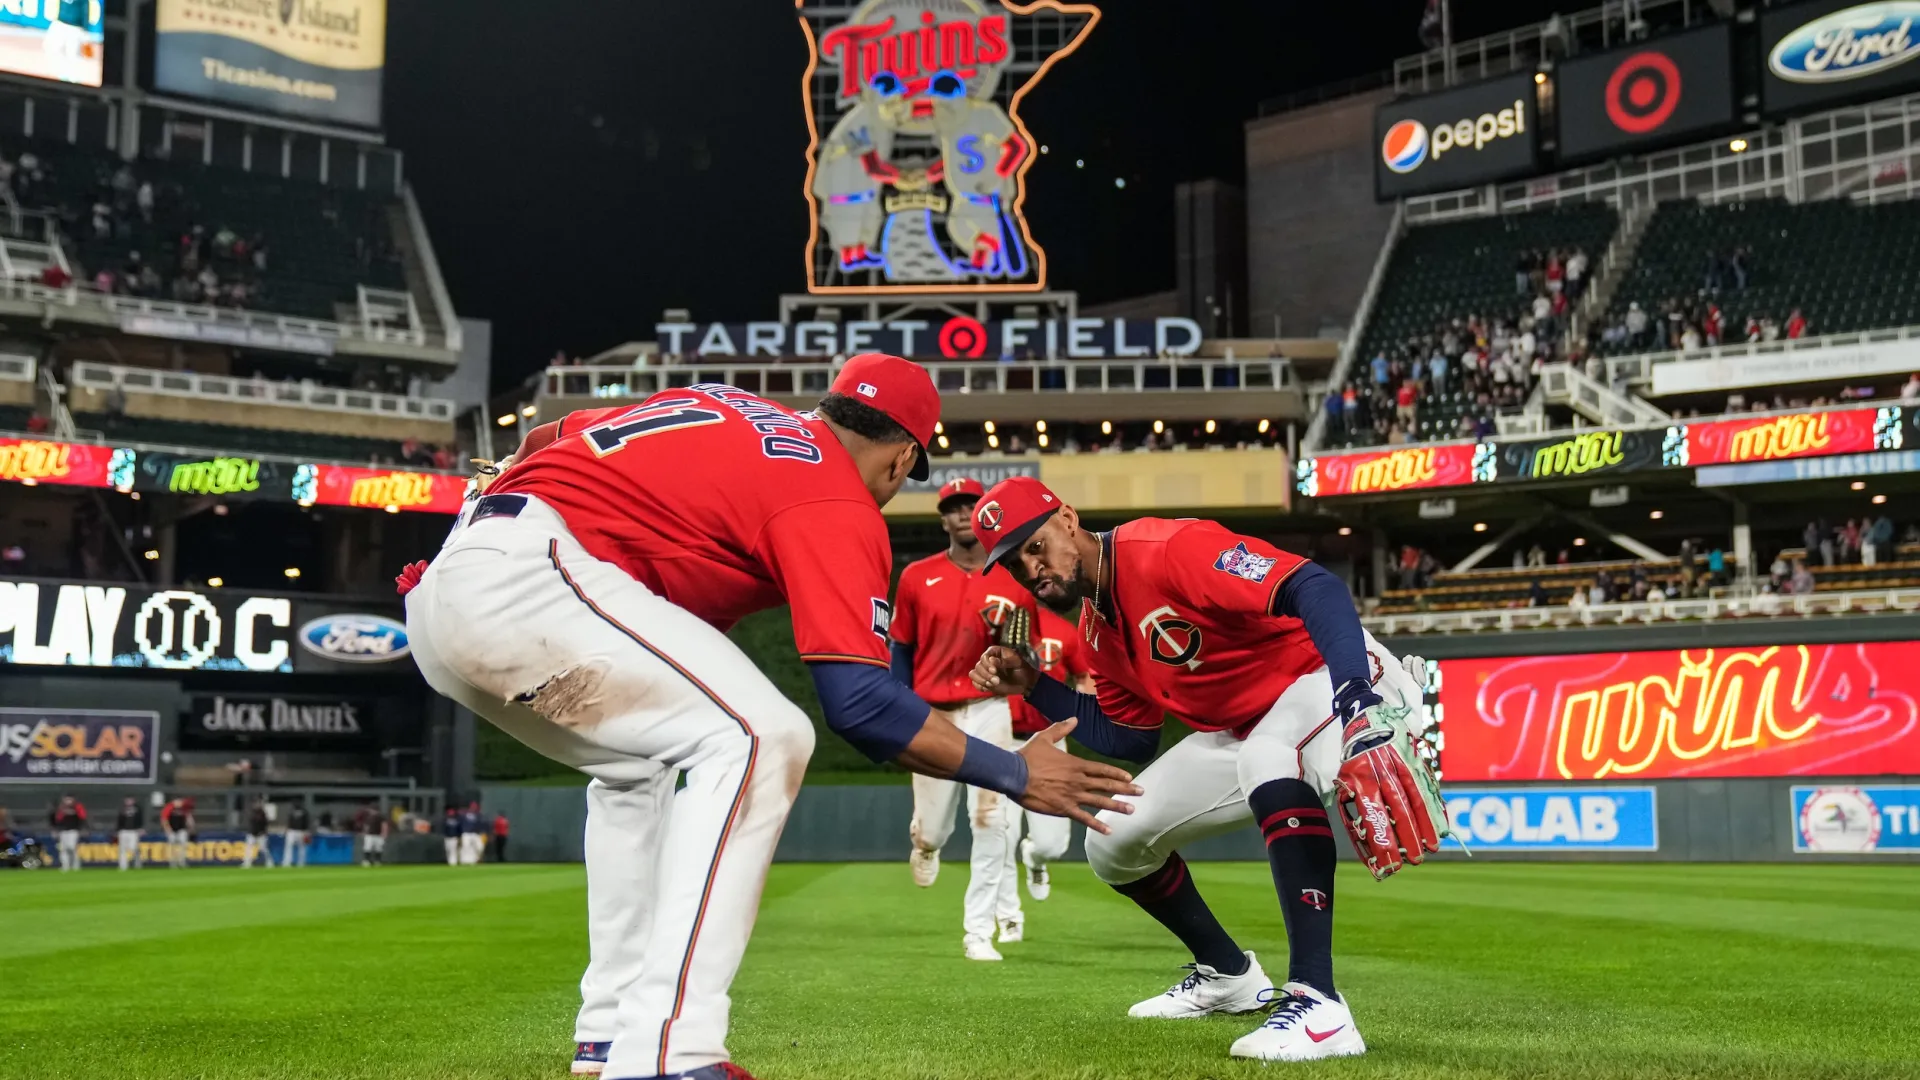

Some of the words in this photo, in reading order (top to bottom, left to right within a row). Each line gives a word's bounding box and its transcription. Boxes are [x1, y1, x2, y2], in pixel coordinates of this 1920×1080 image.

[822, 11, 1009, 98] Twins
[1804, 14, 1913, 73] Ford
[1431, 99, 1525, 161] pepsi
[655, 321, 929, 357] TARGET
[1001, 318, 1203, 358] FIELD
[203, 696, 267, 731] JACK
[271, 698, 361, 733] DANIEL'S
